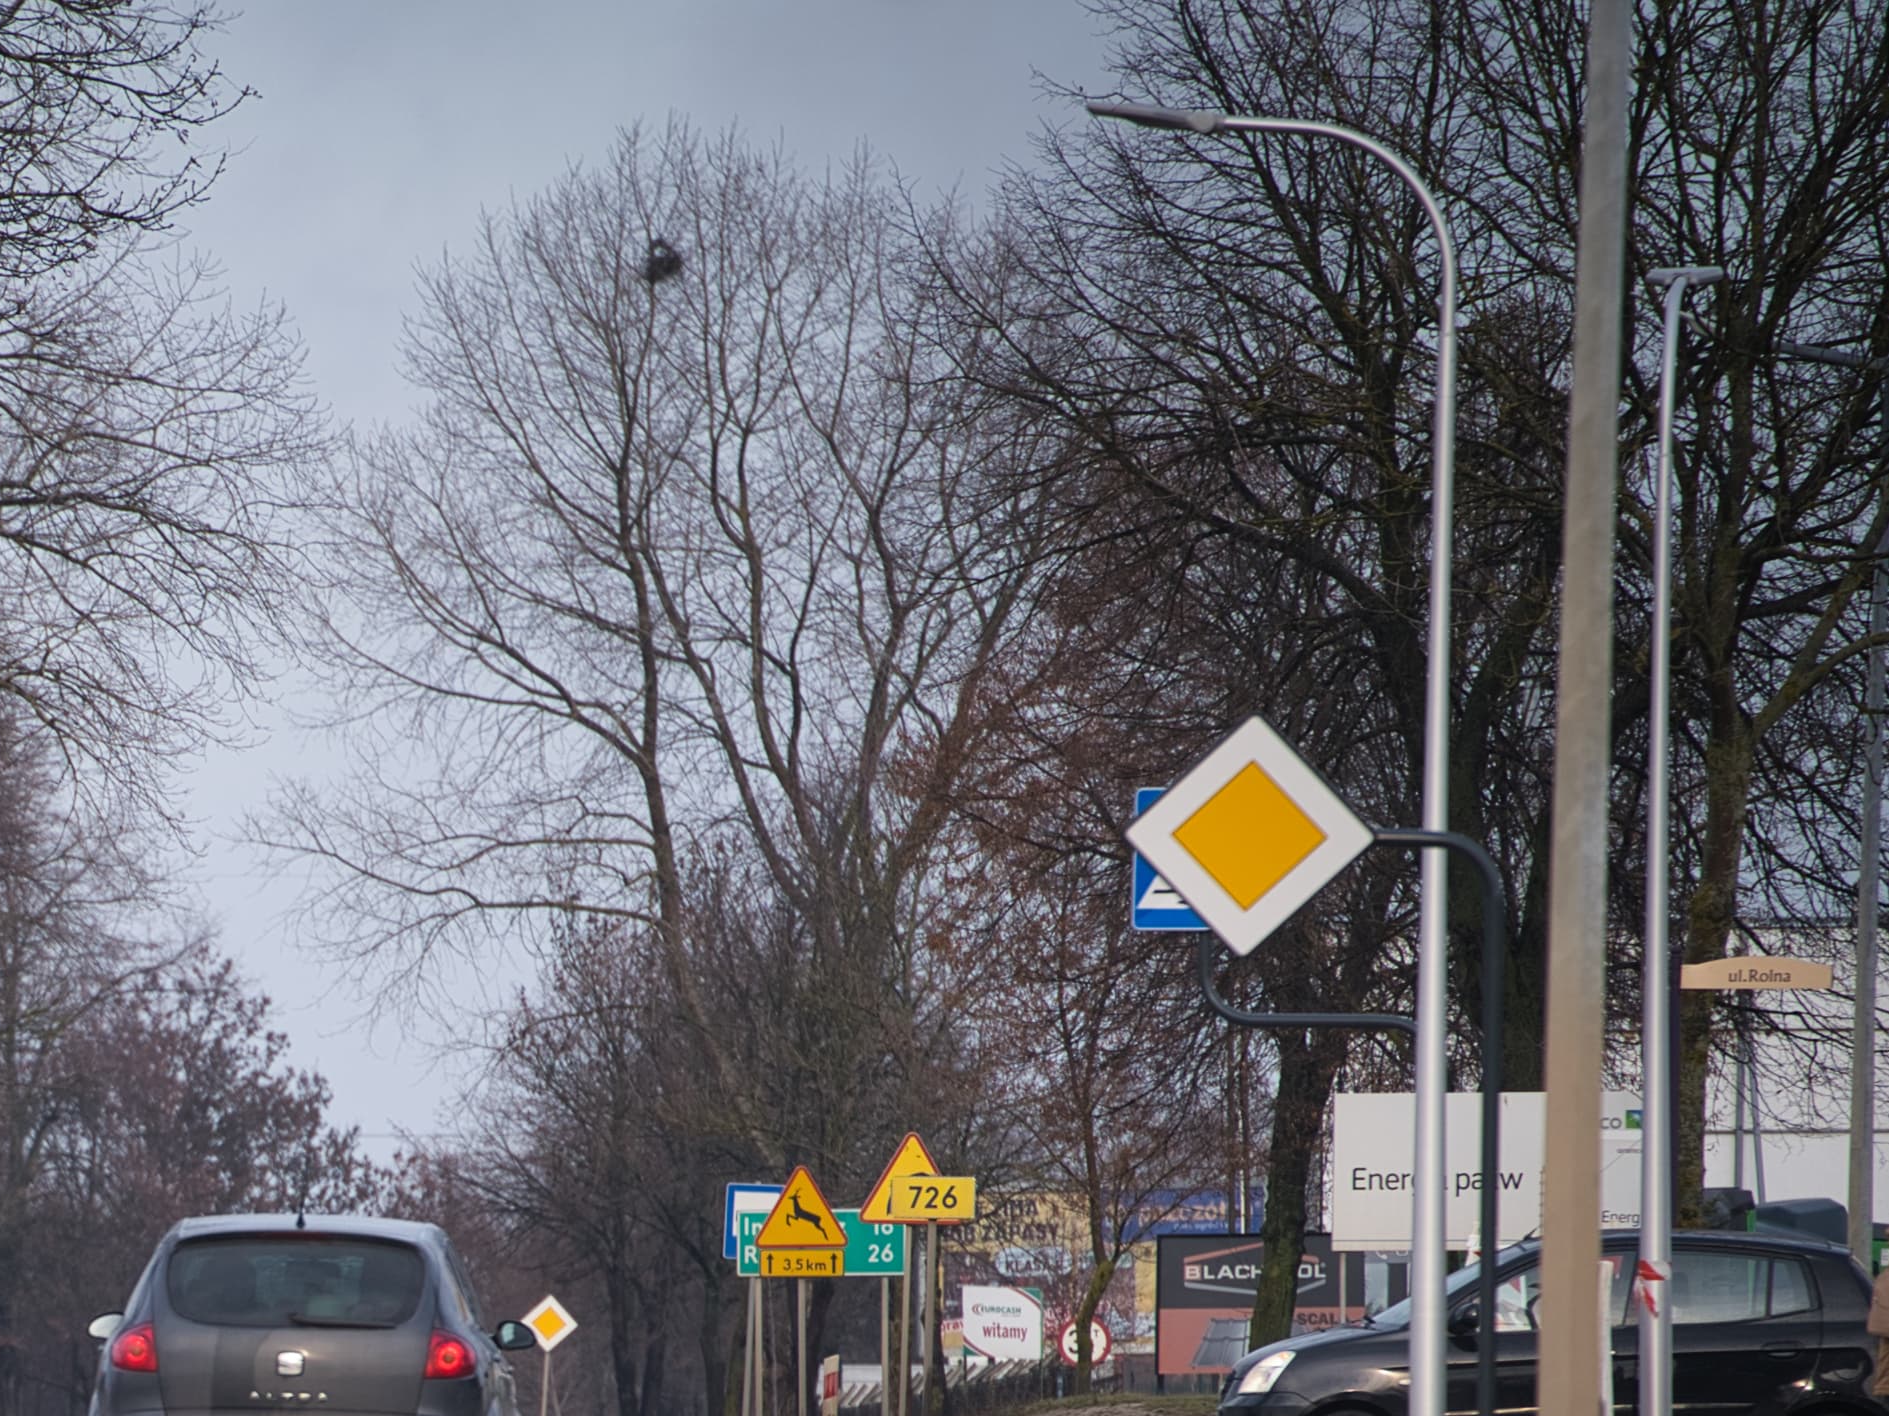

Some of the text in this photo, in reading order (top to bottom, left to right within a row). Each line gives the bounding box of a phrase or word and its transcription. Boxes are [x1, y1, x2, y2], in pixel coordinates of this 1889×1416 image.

[1352, 1168, 1448, 1198] Ener
[909, 1185, 958, 1209] 726
[868, 1244, 894, 1263] 26
[806, 1258, 827, 1272] km
[980, 1305, 1022, 1314] EUROCASH
[982, 1322, 1028, 1342] witamy
